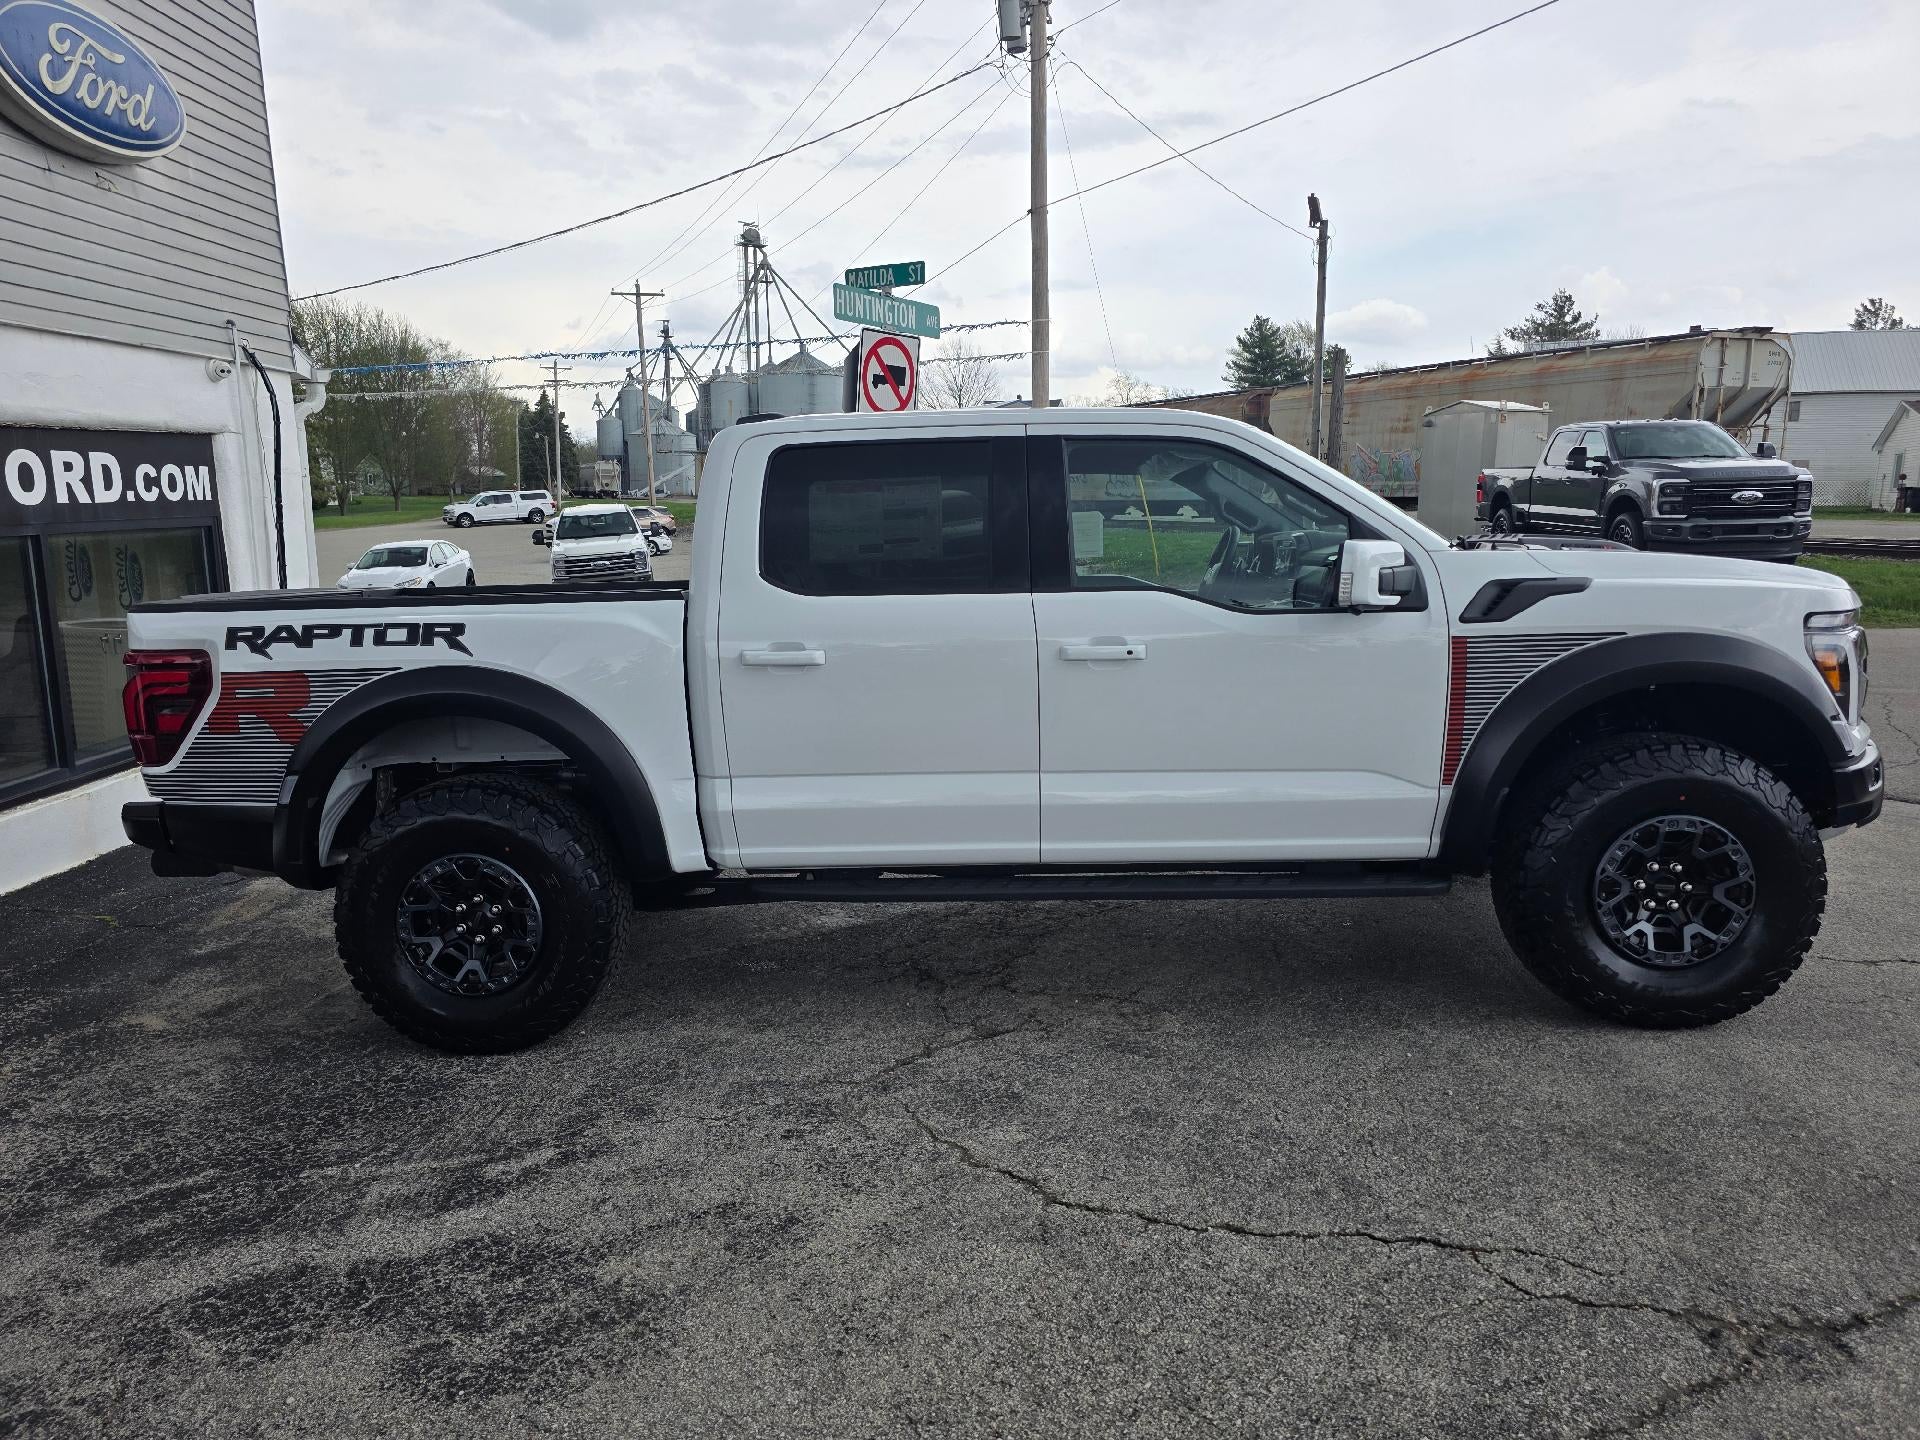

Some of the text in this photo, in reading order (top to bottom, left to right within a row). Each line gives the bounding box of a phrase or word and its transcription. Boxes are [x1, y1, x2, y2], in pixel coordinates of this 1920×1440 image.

[38, 22, 156, 132] Ford
[848, 263, 922, 288] MATILDA ST
[835, 288, 938, 330] HUNTINGTON AVE
[225, 622, 474, 661] RAPTOR
